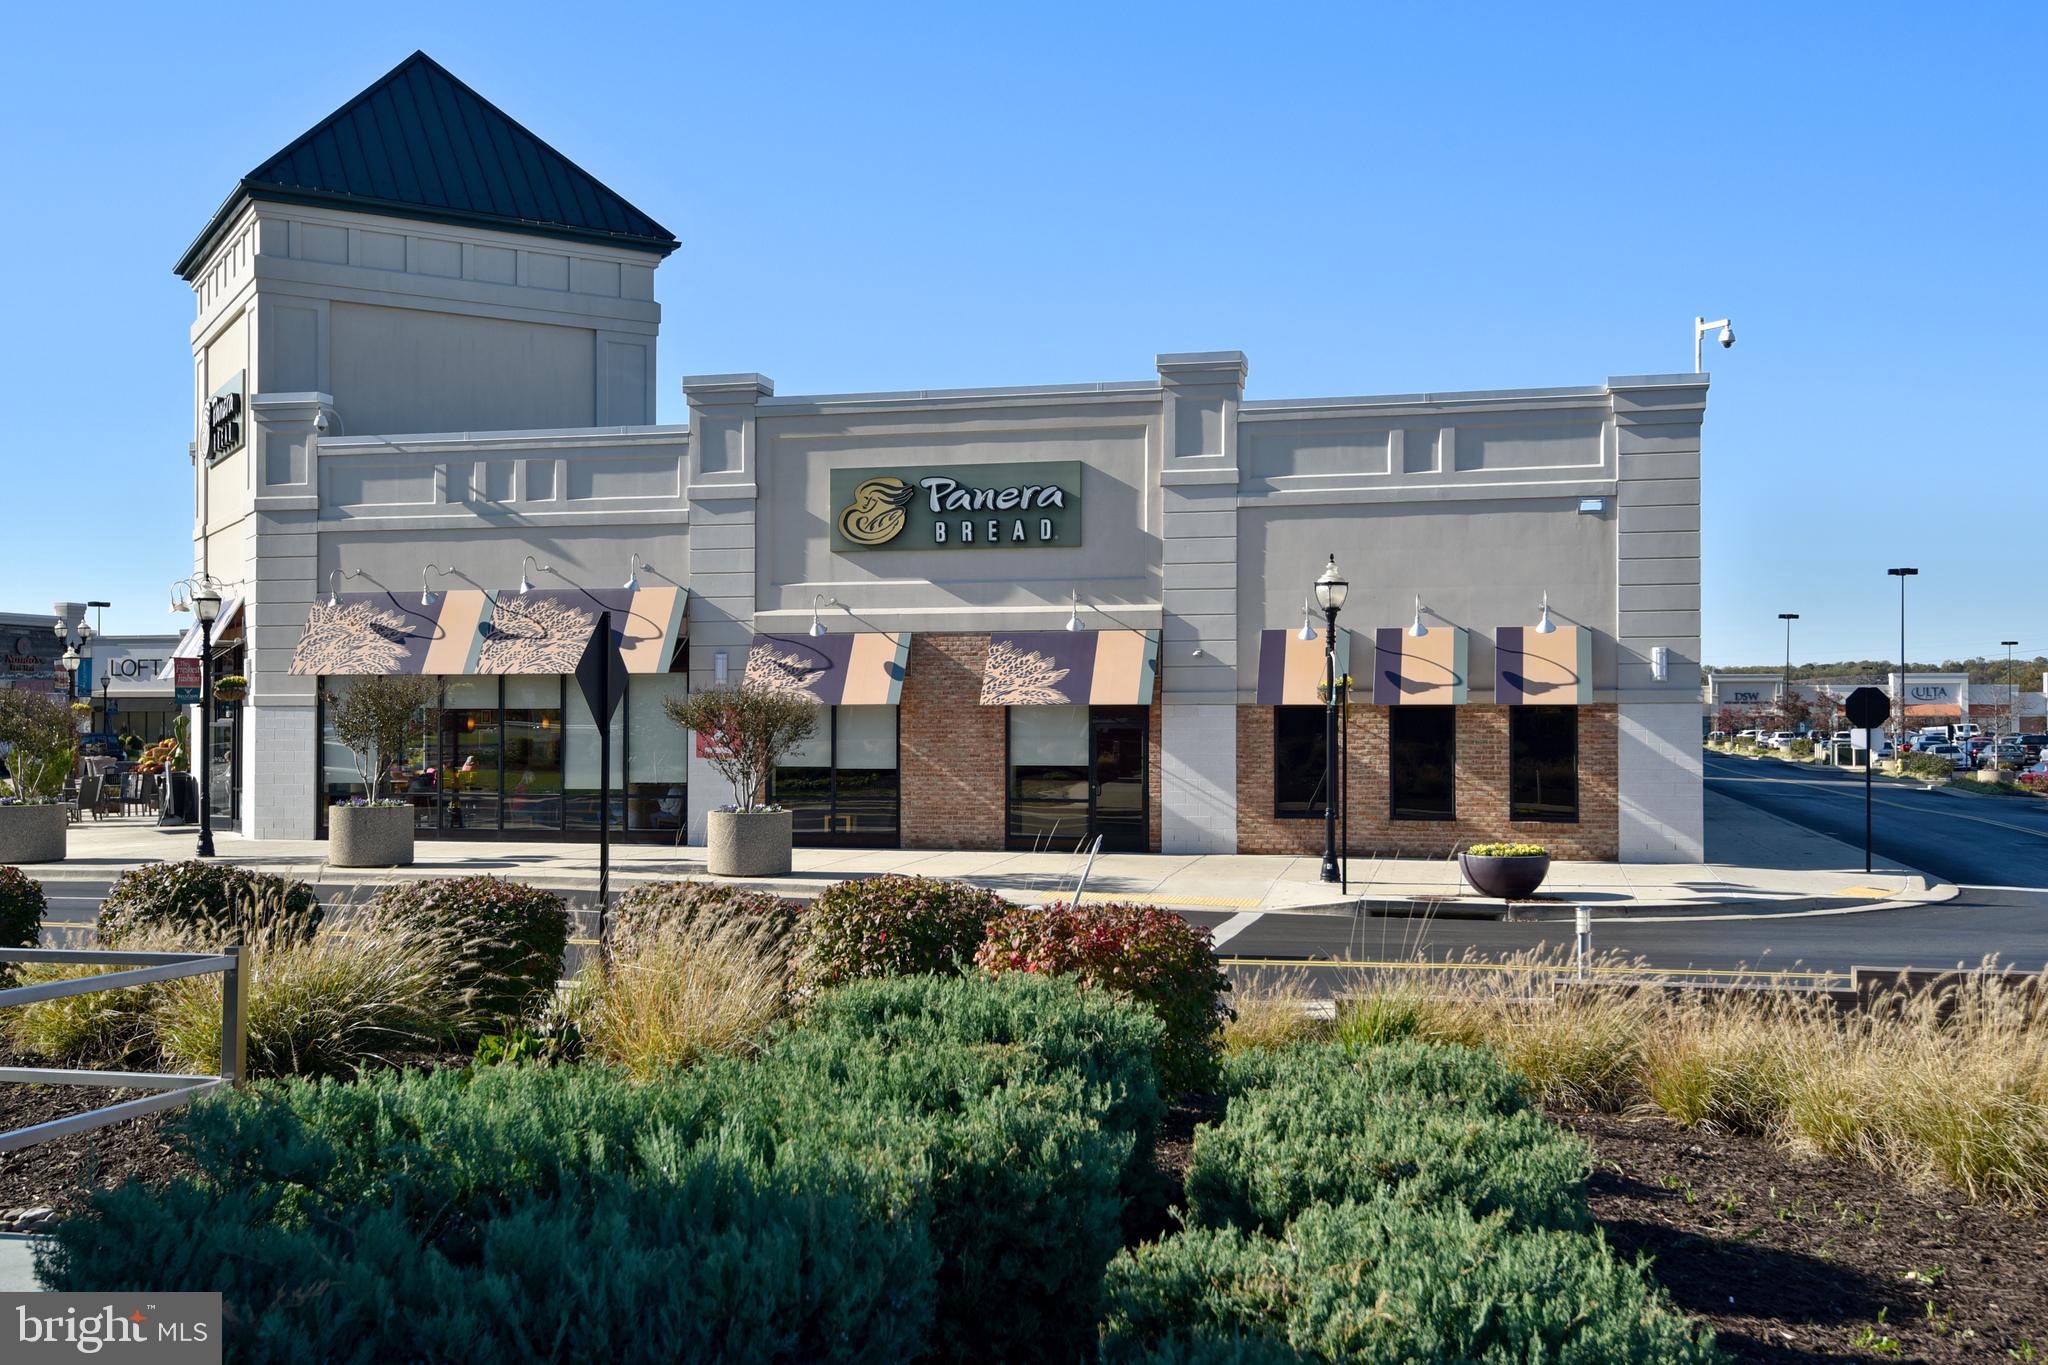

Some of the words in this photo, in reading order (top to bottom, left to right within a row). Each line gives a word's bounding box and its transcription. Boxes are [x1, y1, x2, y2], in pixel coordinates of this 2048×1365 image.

[919, 476, 1064, 513] Panera
[934, 518, 1052, 543] BREAD
[110, 658, 163, 677] LOFT
[1734, 692, 1759, 701] DSW
[1915, 686, 1948, 697] ULTA
